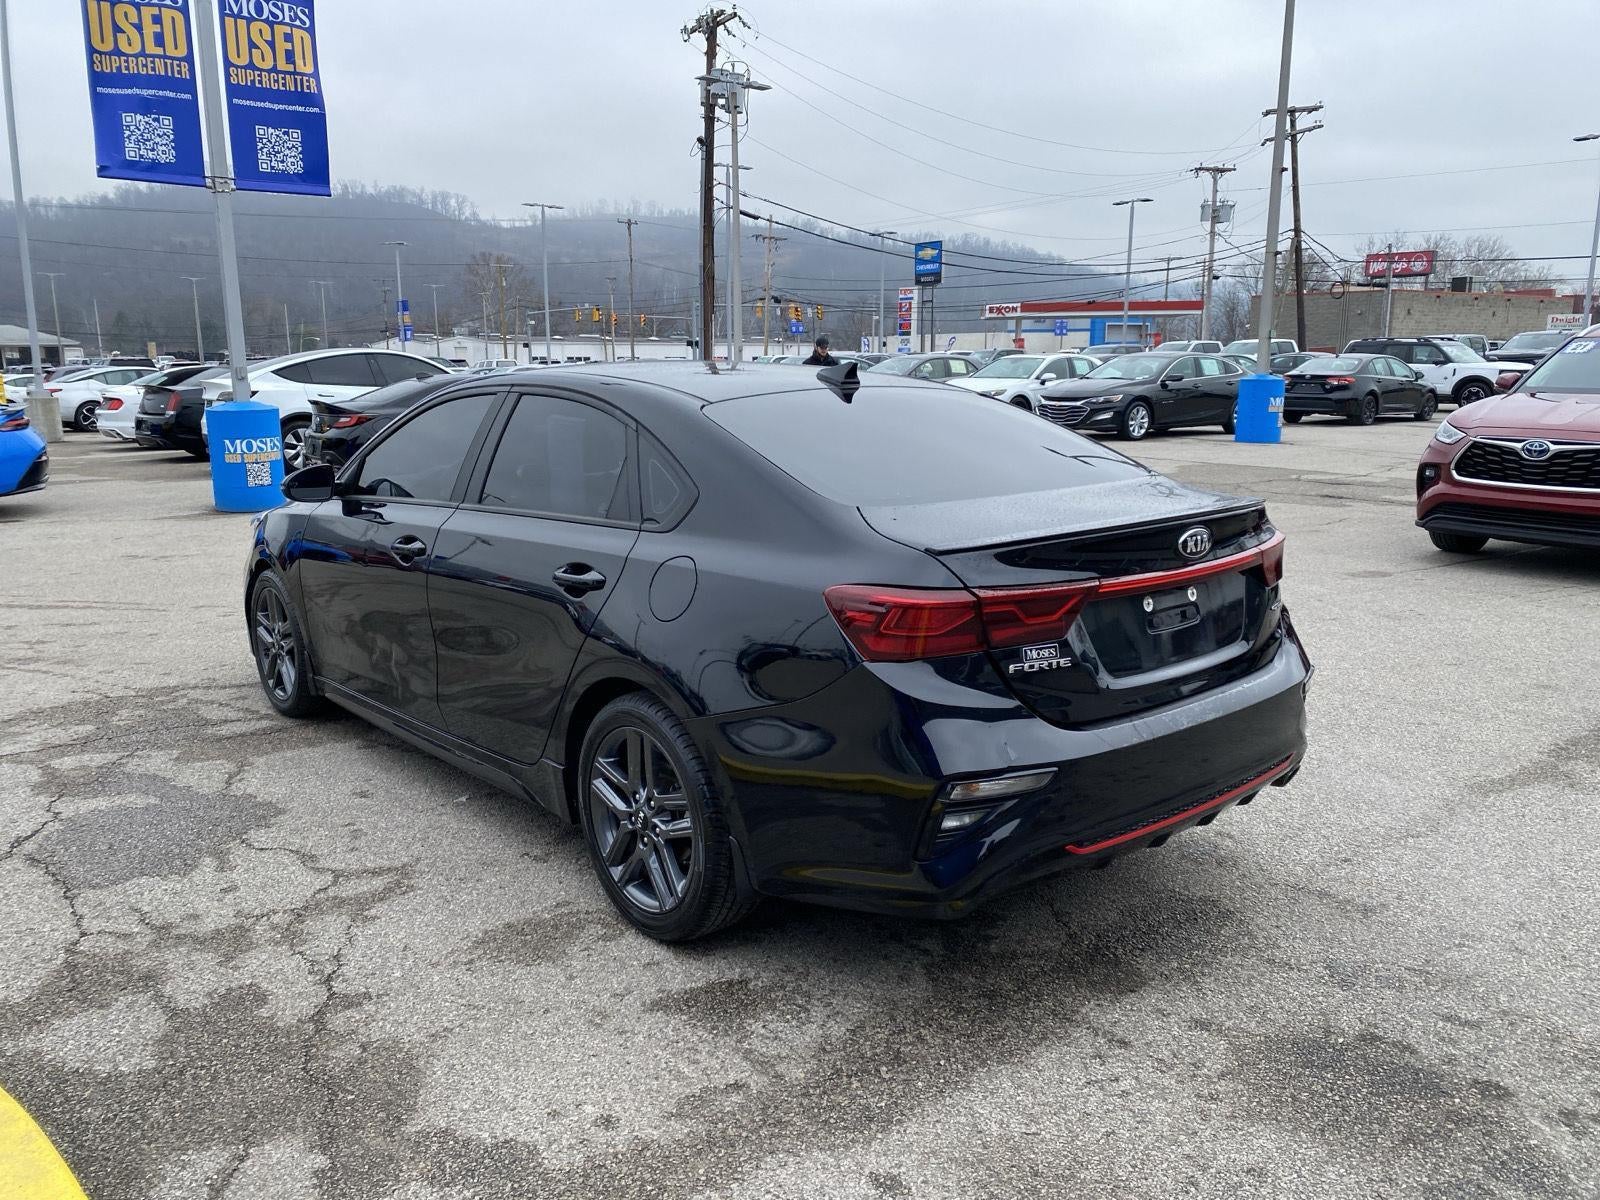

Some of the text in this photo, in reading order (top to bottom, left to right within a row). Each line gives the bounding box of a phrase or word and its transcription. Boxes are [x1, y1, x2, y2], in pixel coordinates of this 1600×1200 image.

[224, 0, 310, 28] MOSES
[87, 0, 187, 57] USED
[225, 16, 314, 74] USED
[93, 54, 190, 79] SUPERCENTER
[229, 67, 318, 94] SUPERCENTER
[96, 86, 192, 100] mosesusedsupercenter.com
[232, 98, 320, 113] mosesusedsupercenter.com
[988, 305, 1018, 316] EXXON
[224, 437, 281, 454] MOSES
[1187, 534, 1209, 553] KIA
[1026, 648, 1056, 660] MOSES
[1009, 658, 1072, 673] FORTE
